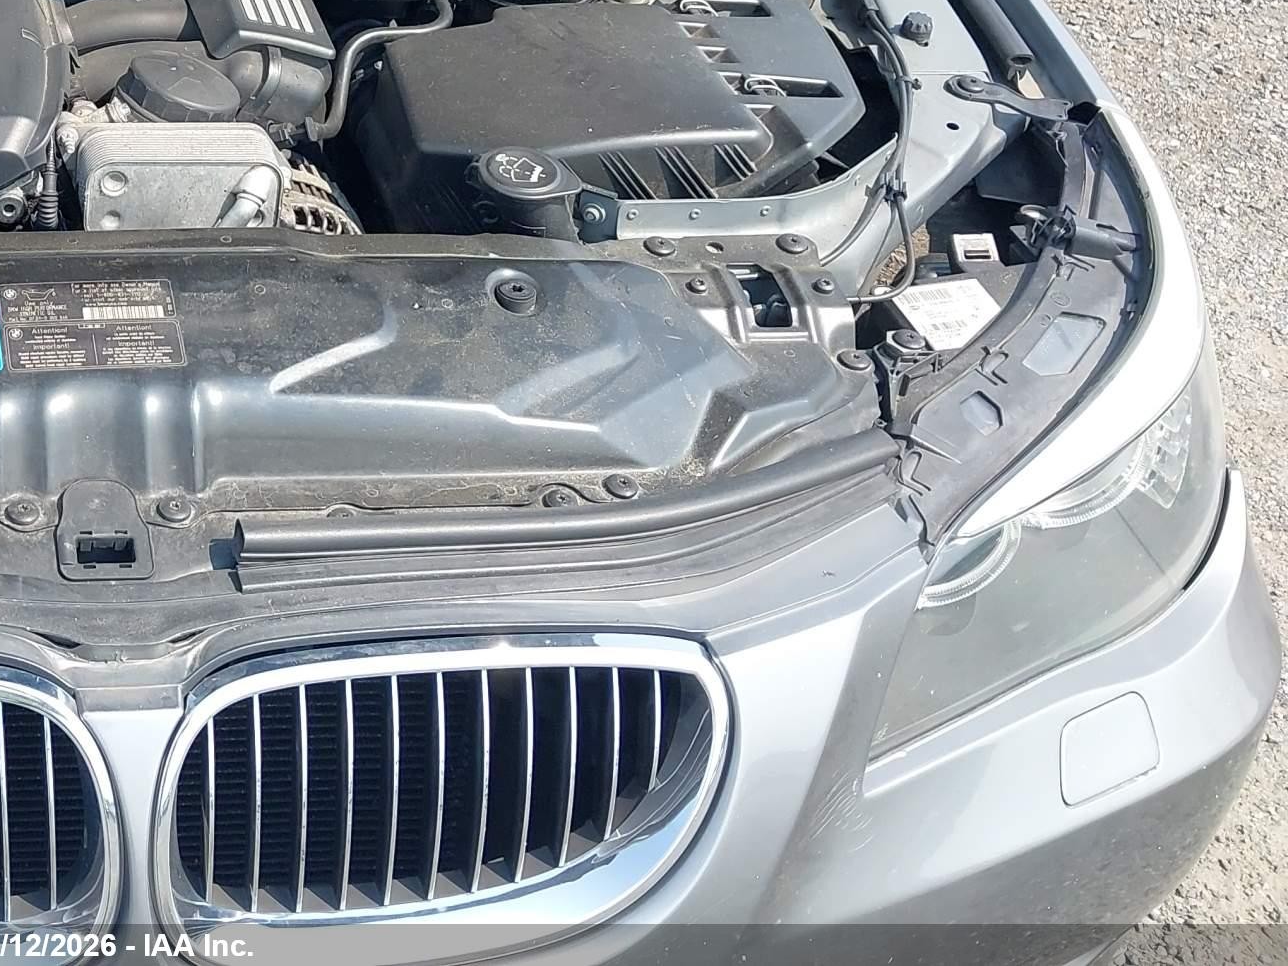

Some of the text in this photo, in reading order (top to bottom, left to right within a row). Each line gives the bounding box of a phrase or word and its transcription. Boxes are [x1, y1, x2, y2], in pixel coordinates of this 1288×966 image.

[31, 326, 68, 335] Attention!
[115, 324, 152, 332] Attention!
[32, 342, 70, 351] Important!
